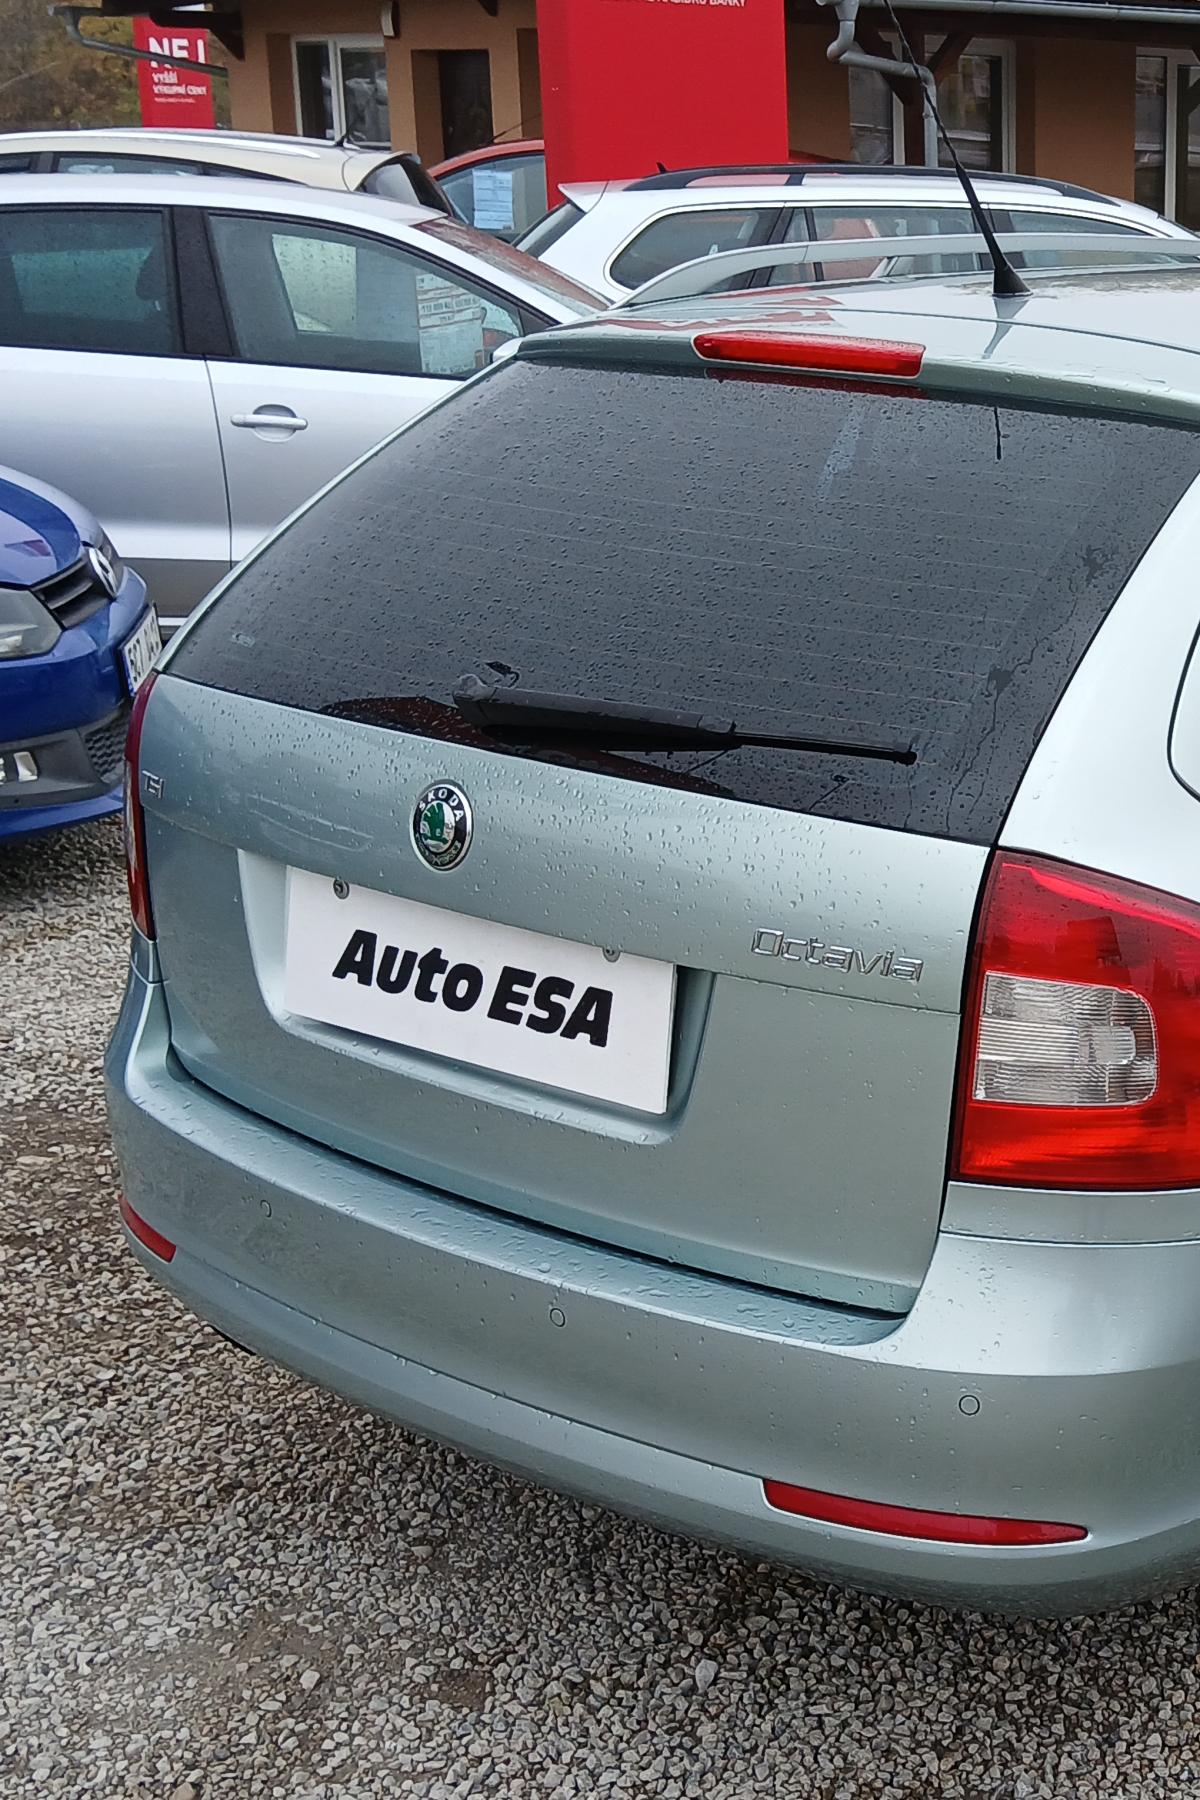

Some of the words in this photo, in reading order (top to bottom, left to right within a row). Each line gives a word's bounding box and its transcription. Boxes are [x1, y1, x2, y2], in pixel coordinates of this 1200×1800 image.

[332, 929, 483, 1012] Auto
[487, 965, 613, 1048] ESA
[752, 927, 923, 982] Octavia
